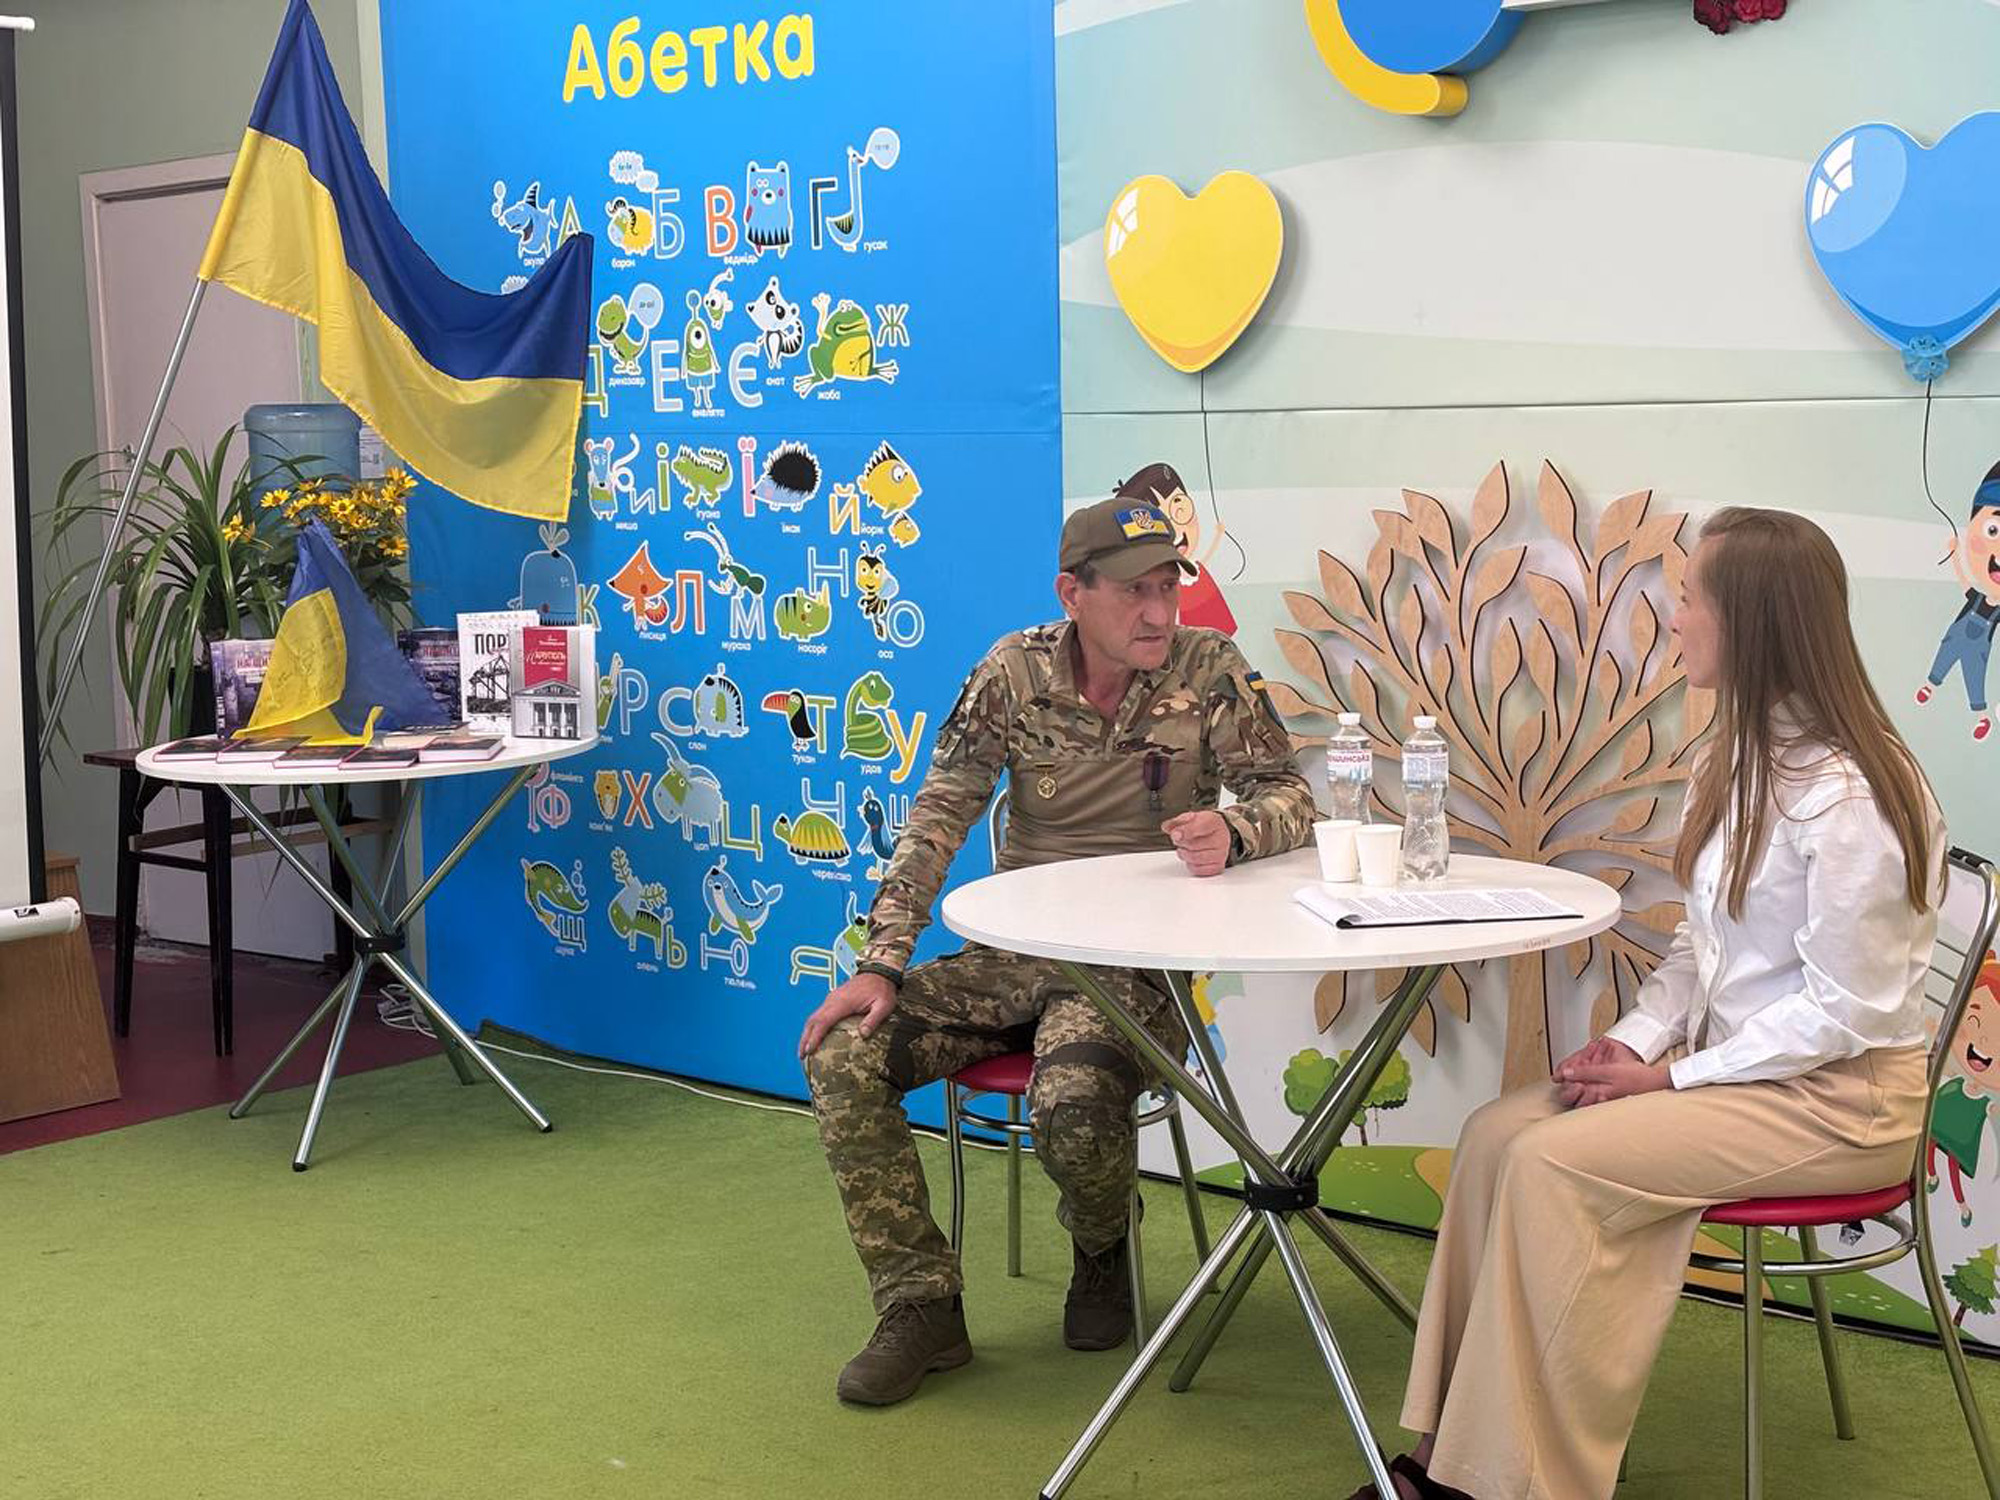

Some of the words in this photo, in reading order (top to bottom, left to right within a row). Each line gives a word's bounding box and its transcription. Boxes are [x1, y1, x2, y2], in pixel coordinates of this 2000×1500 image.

[563, 14, 814, 102] Абетка
[652, 188, 685, 259] Б
[704, 185, 738, 257] В
[809, 177, 838, 249] Г
[611, 258, 636, 269] баран
[723, 253, 759, 265] ведмідь
[875, 304, 911, 347] Ж
[608, 377, 646, 387] динозавр
[651, 339, 684, 412] Е
[728, 342, 763, 407] Є
[817, 388, 841, 400] жаба
[829, 483, 860, 535] Й
[808, 547, 849, 597] Н
[670, 570, 706, 635] Л
[730, 596, 766, 640] М
[887, 600, 925, 648] О
[474, 633, 509, 655] ПОР
[878, 650, 894, 659] оса
[618, 668, 649, 735] Р
[658, 687, 694, 737] С
[806, 694, 836, 753] Т
[688, 741, 707, 750] слон
[860, 765, 883, 775] удав
[536, 784, 571, 829] Ф
[622, 770, 654, 830] Х
[722, 800, 763, 862] Ц
[557, 913, 587, 953] Щ
[700, 933, 750, 977] Ю
[790, 945, 837, 991] Я
